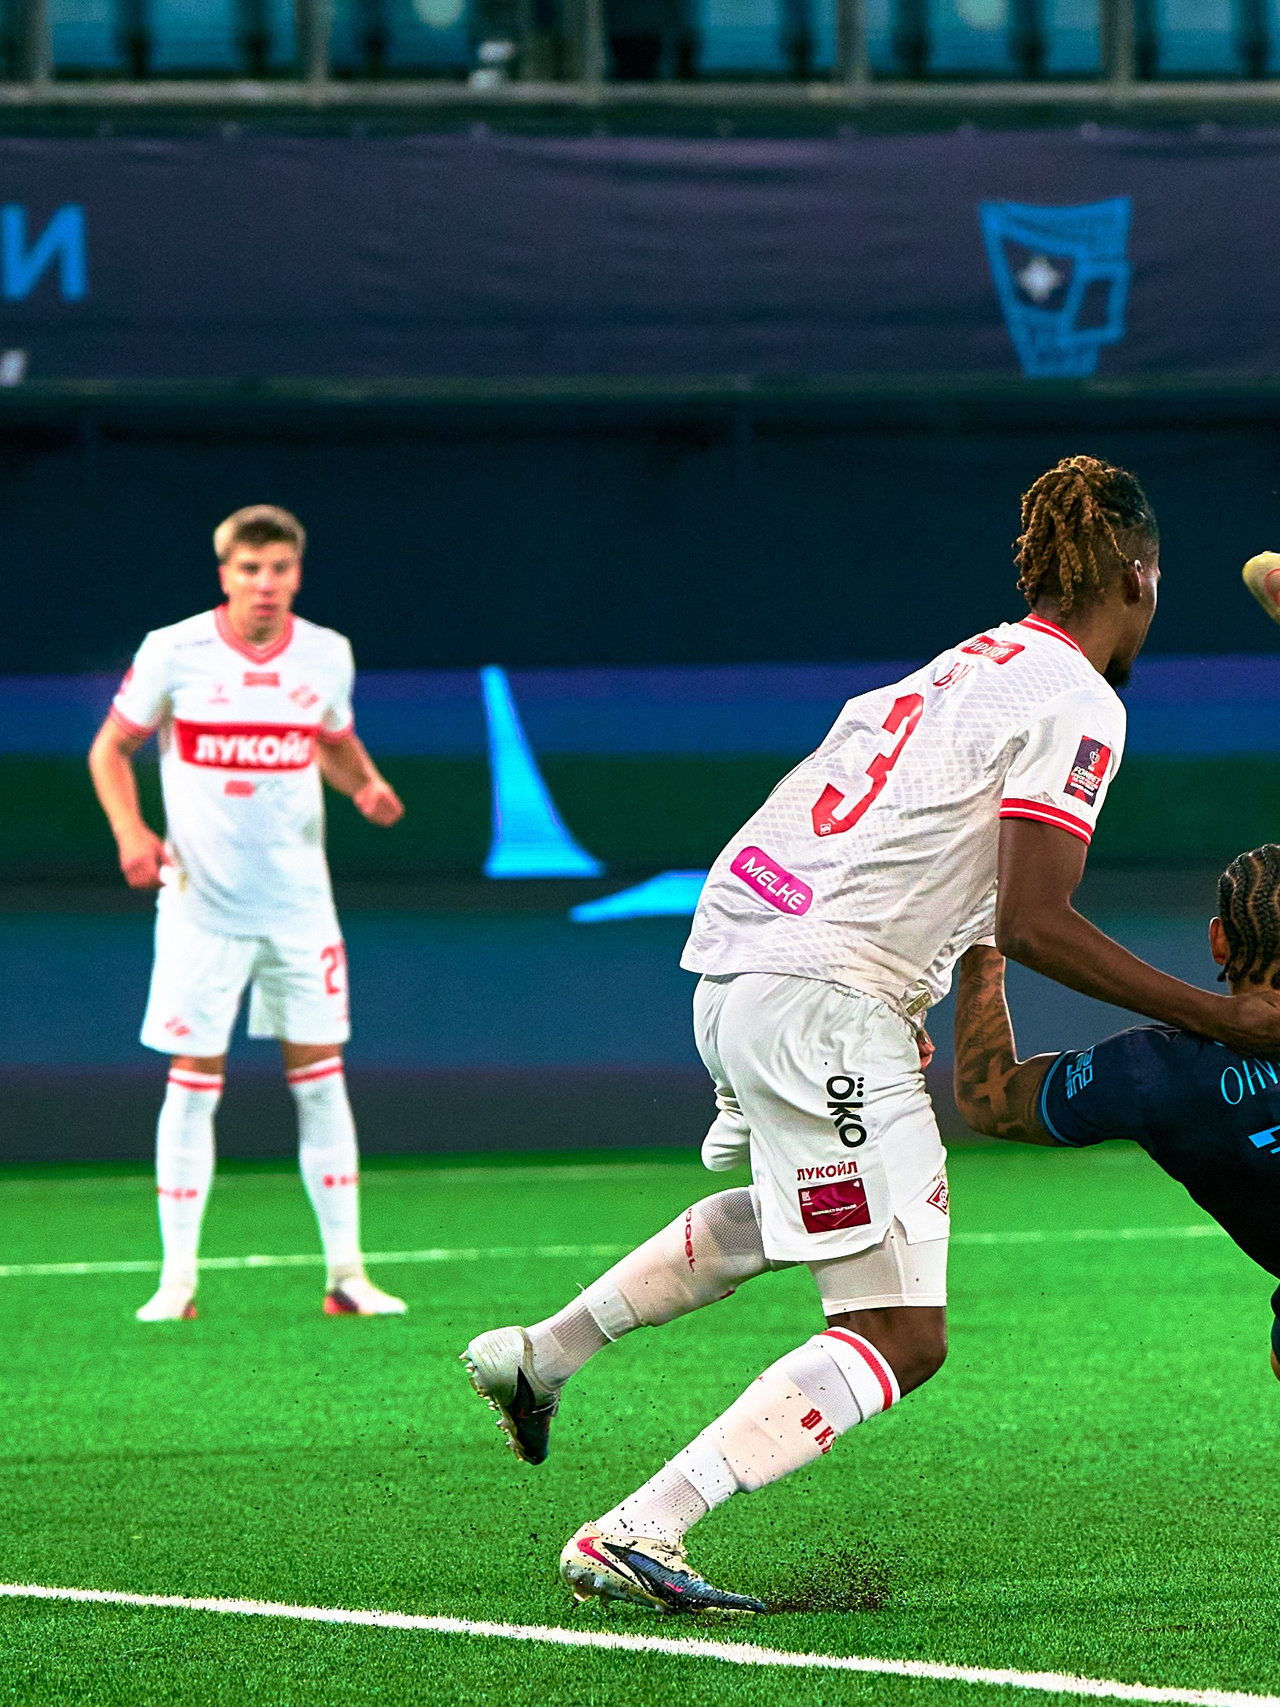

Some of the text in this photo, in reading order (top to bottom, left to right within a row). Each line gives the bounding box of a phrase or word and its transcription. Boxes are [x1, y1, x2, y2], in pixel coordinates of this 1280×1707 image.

[811, 692, 924, 838] 3
[741, 856, 807, 911] MELKE
[797, 1160, 859, 1182] ЛУКОЙЛ
